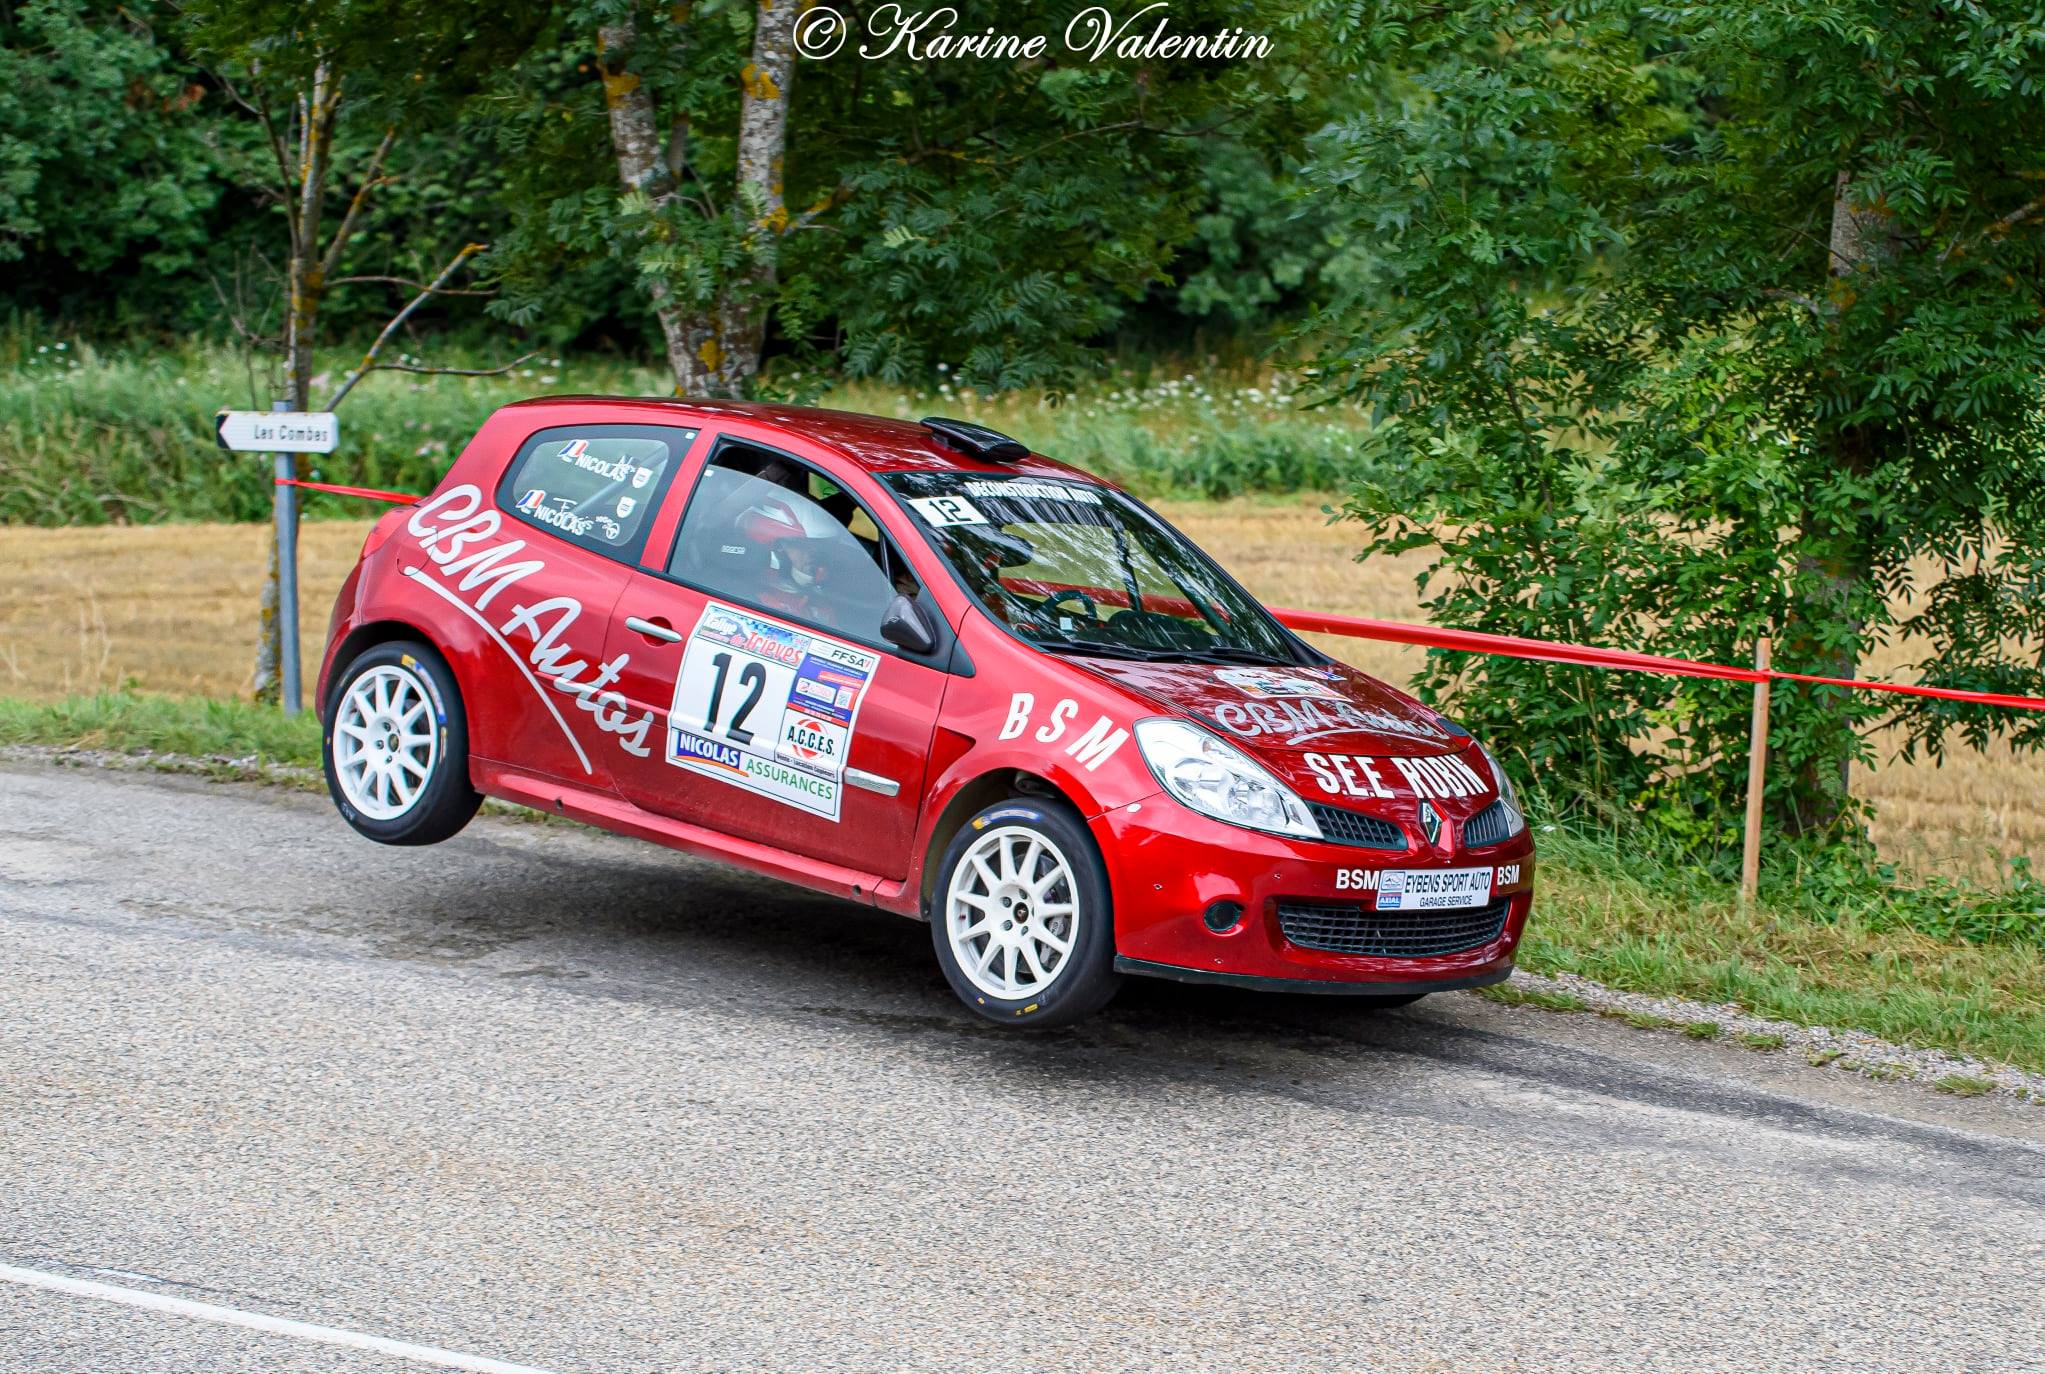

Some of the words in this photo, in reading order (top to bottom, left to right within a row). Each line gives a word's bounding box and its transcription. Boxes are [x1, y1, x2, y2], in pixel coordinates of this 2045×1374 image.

[254, 425, 273, 440] Les
[280, 425, 328, 441] Combes
[574, 453, 627, 482] NICOLAS
[534, 505, 585, 536] NICOLAS
[927, 499, 974, 523] 12
[407, 484, 545, 612] CBM
[500, 597, 655, 758] Autos
[831, 649, 865, 668] FFSA
[703, 651, 767, 746] 12
[1213, 698, 1336, 738] CBM
[787, 725, 835, 756] A.C.C.E.S.
[679, 732, 740, 768] NICOLAS
[746, 758, 833, 800] ASSURANCES
[1392, 755, 1489, 800] ROBIN
[1335, 868, 1380, 890] BSM
[1404, 874, 1440, 894] EYBENS
[1440, 873, 1470, 893] SPORT
[1469, 871, 1491, 892] AUTO
[1497, 864, 1521, 886] BSM
[1419, 896, 1447, 908] GARAGE
[1446, 895, 1473, 906] SERVICE
